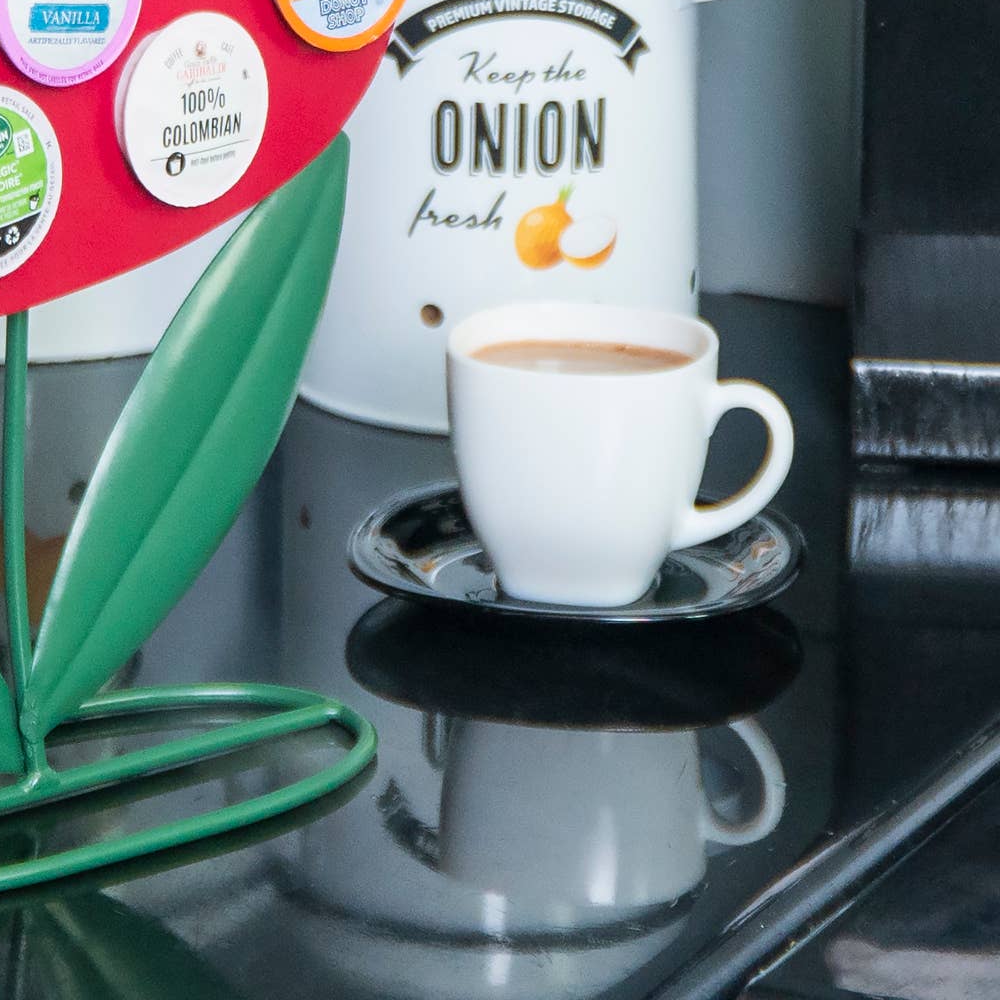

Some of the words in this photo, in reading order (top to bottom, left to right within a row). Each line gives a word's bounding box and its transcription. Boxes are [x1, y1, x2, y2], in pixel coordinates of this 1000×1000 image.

[42, 10, 100, 25] VANILLA
[327, 6, 366, 30] SHOP
[427, 0, 493, 33] PREMIUM
[458, 50, 537, 95] Keep
[542, 49, 587, 84] the
[181, 86, 226, 115] 100%
[162, 112, 242, 149] COLOMBIAN
[431, 97, 607, 178] ONION
[407, 187, 507, 239] fresh
